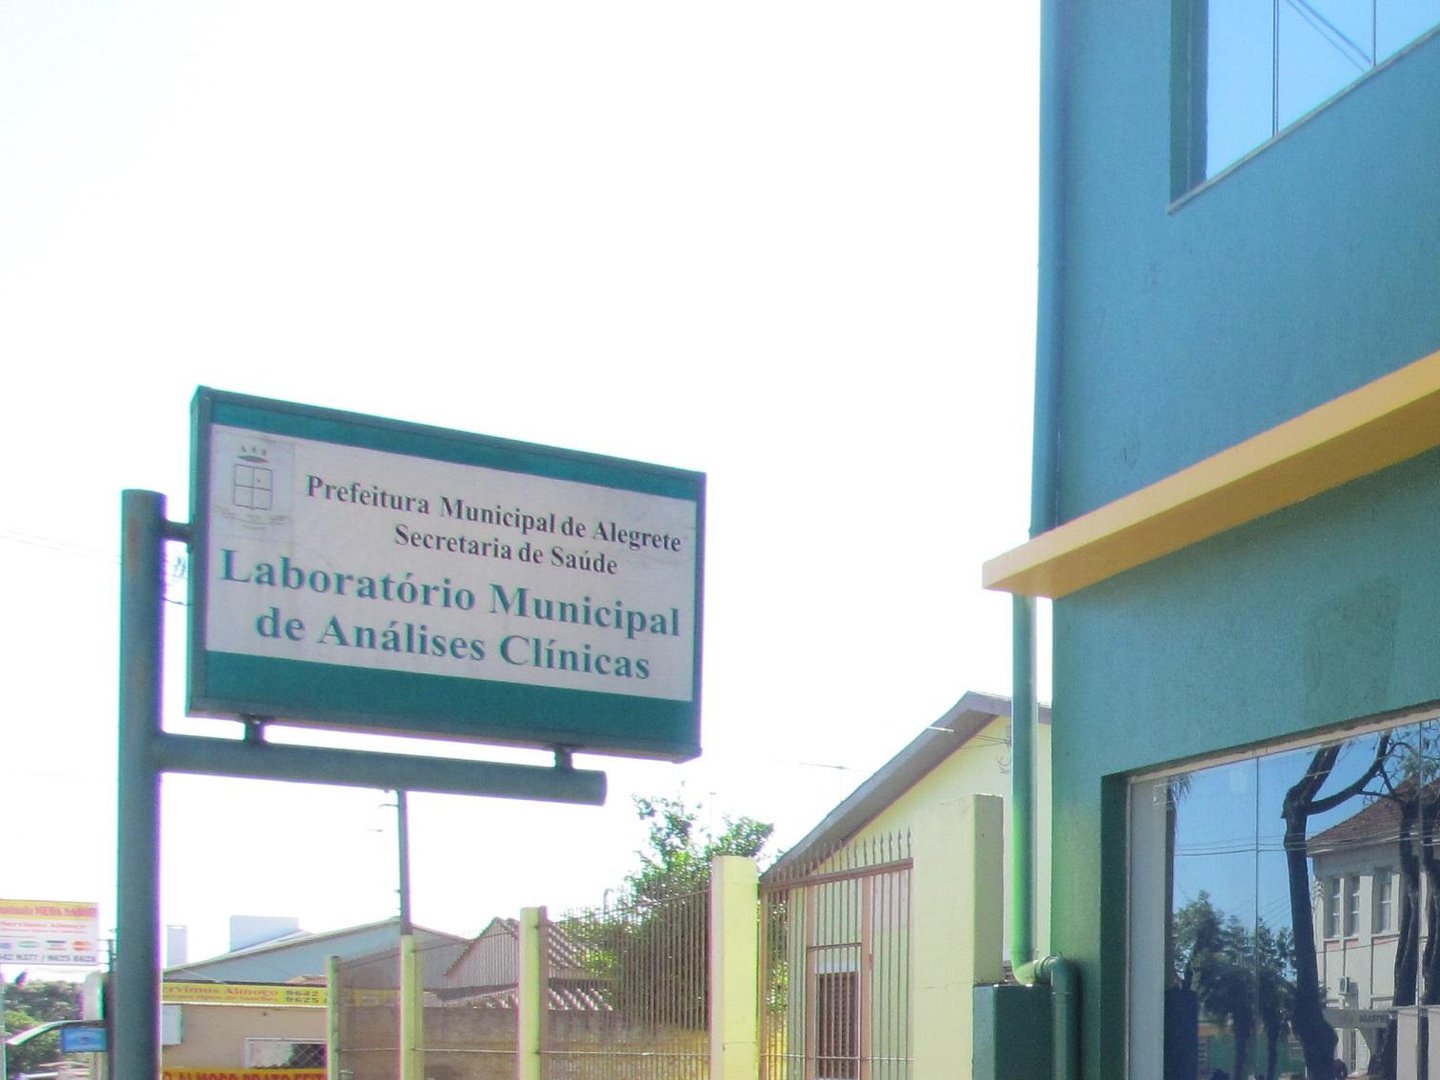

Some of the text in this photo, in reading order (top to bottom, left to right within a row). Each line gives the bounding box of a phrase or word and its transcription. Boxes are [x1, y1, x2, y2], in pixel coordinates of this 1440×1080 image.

[306, 473, 682, 551] Prefeitura Municipal de Alegrete
[394, 523, 619, 575] Secretaria de Saúde
[220, 548, 681, 640] Laboratório Municipal
[255, 606, 650, 680] de Análises Clínicas
